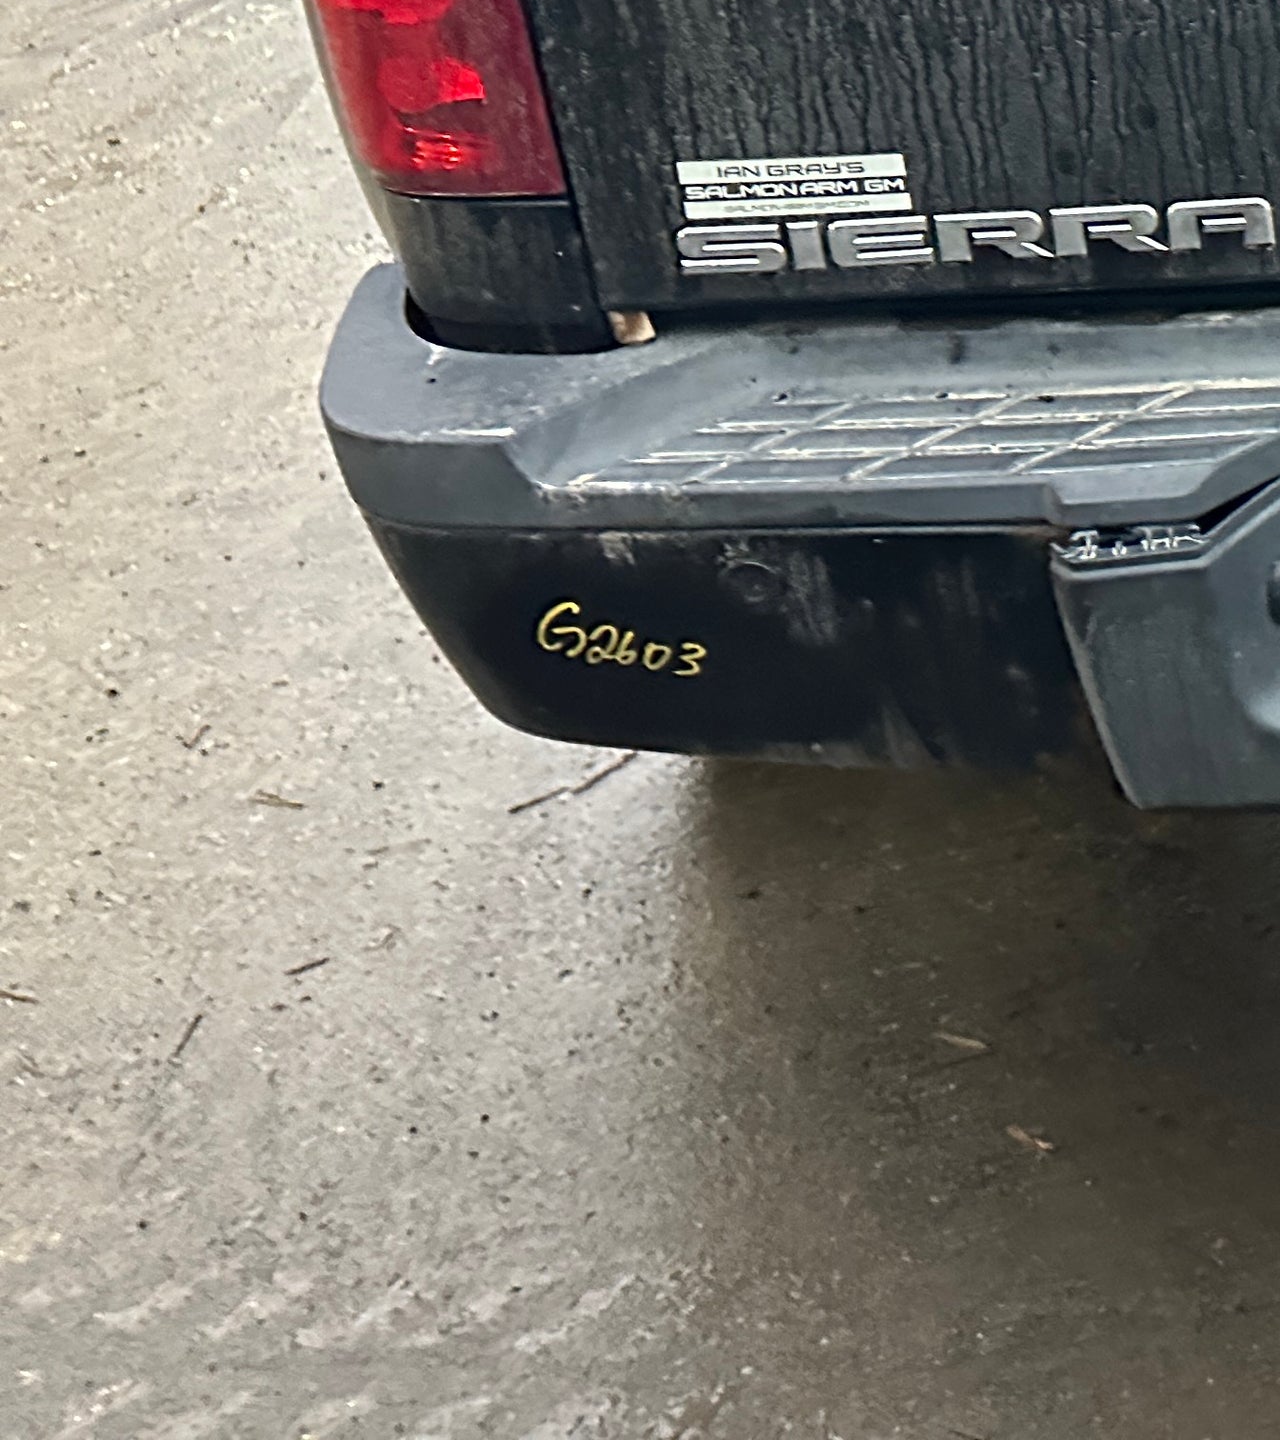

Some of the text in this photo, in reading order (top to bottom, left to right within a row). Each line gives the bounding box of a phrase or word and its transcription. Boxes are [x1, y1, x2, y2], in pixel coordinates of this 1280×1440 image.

[717, 162, 865, 178] IAN GRAY'S
[685, 178, 905, 200] SALMON ARM GM
[677, 197, 1276, 275] SIERRA
